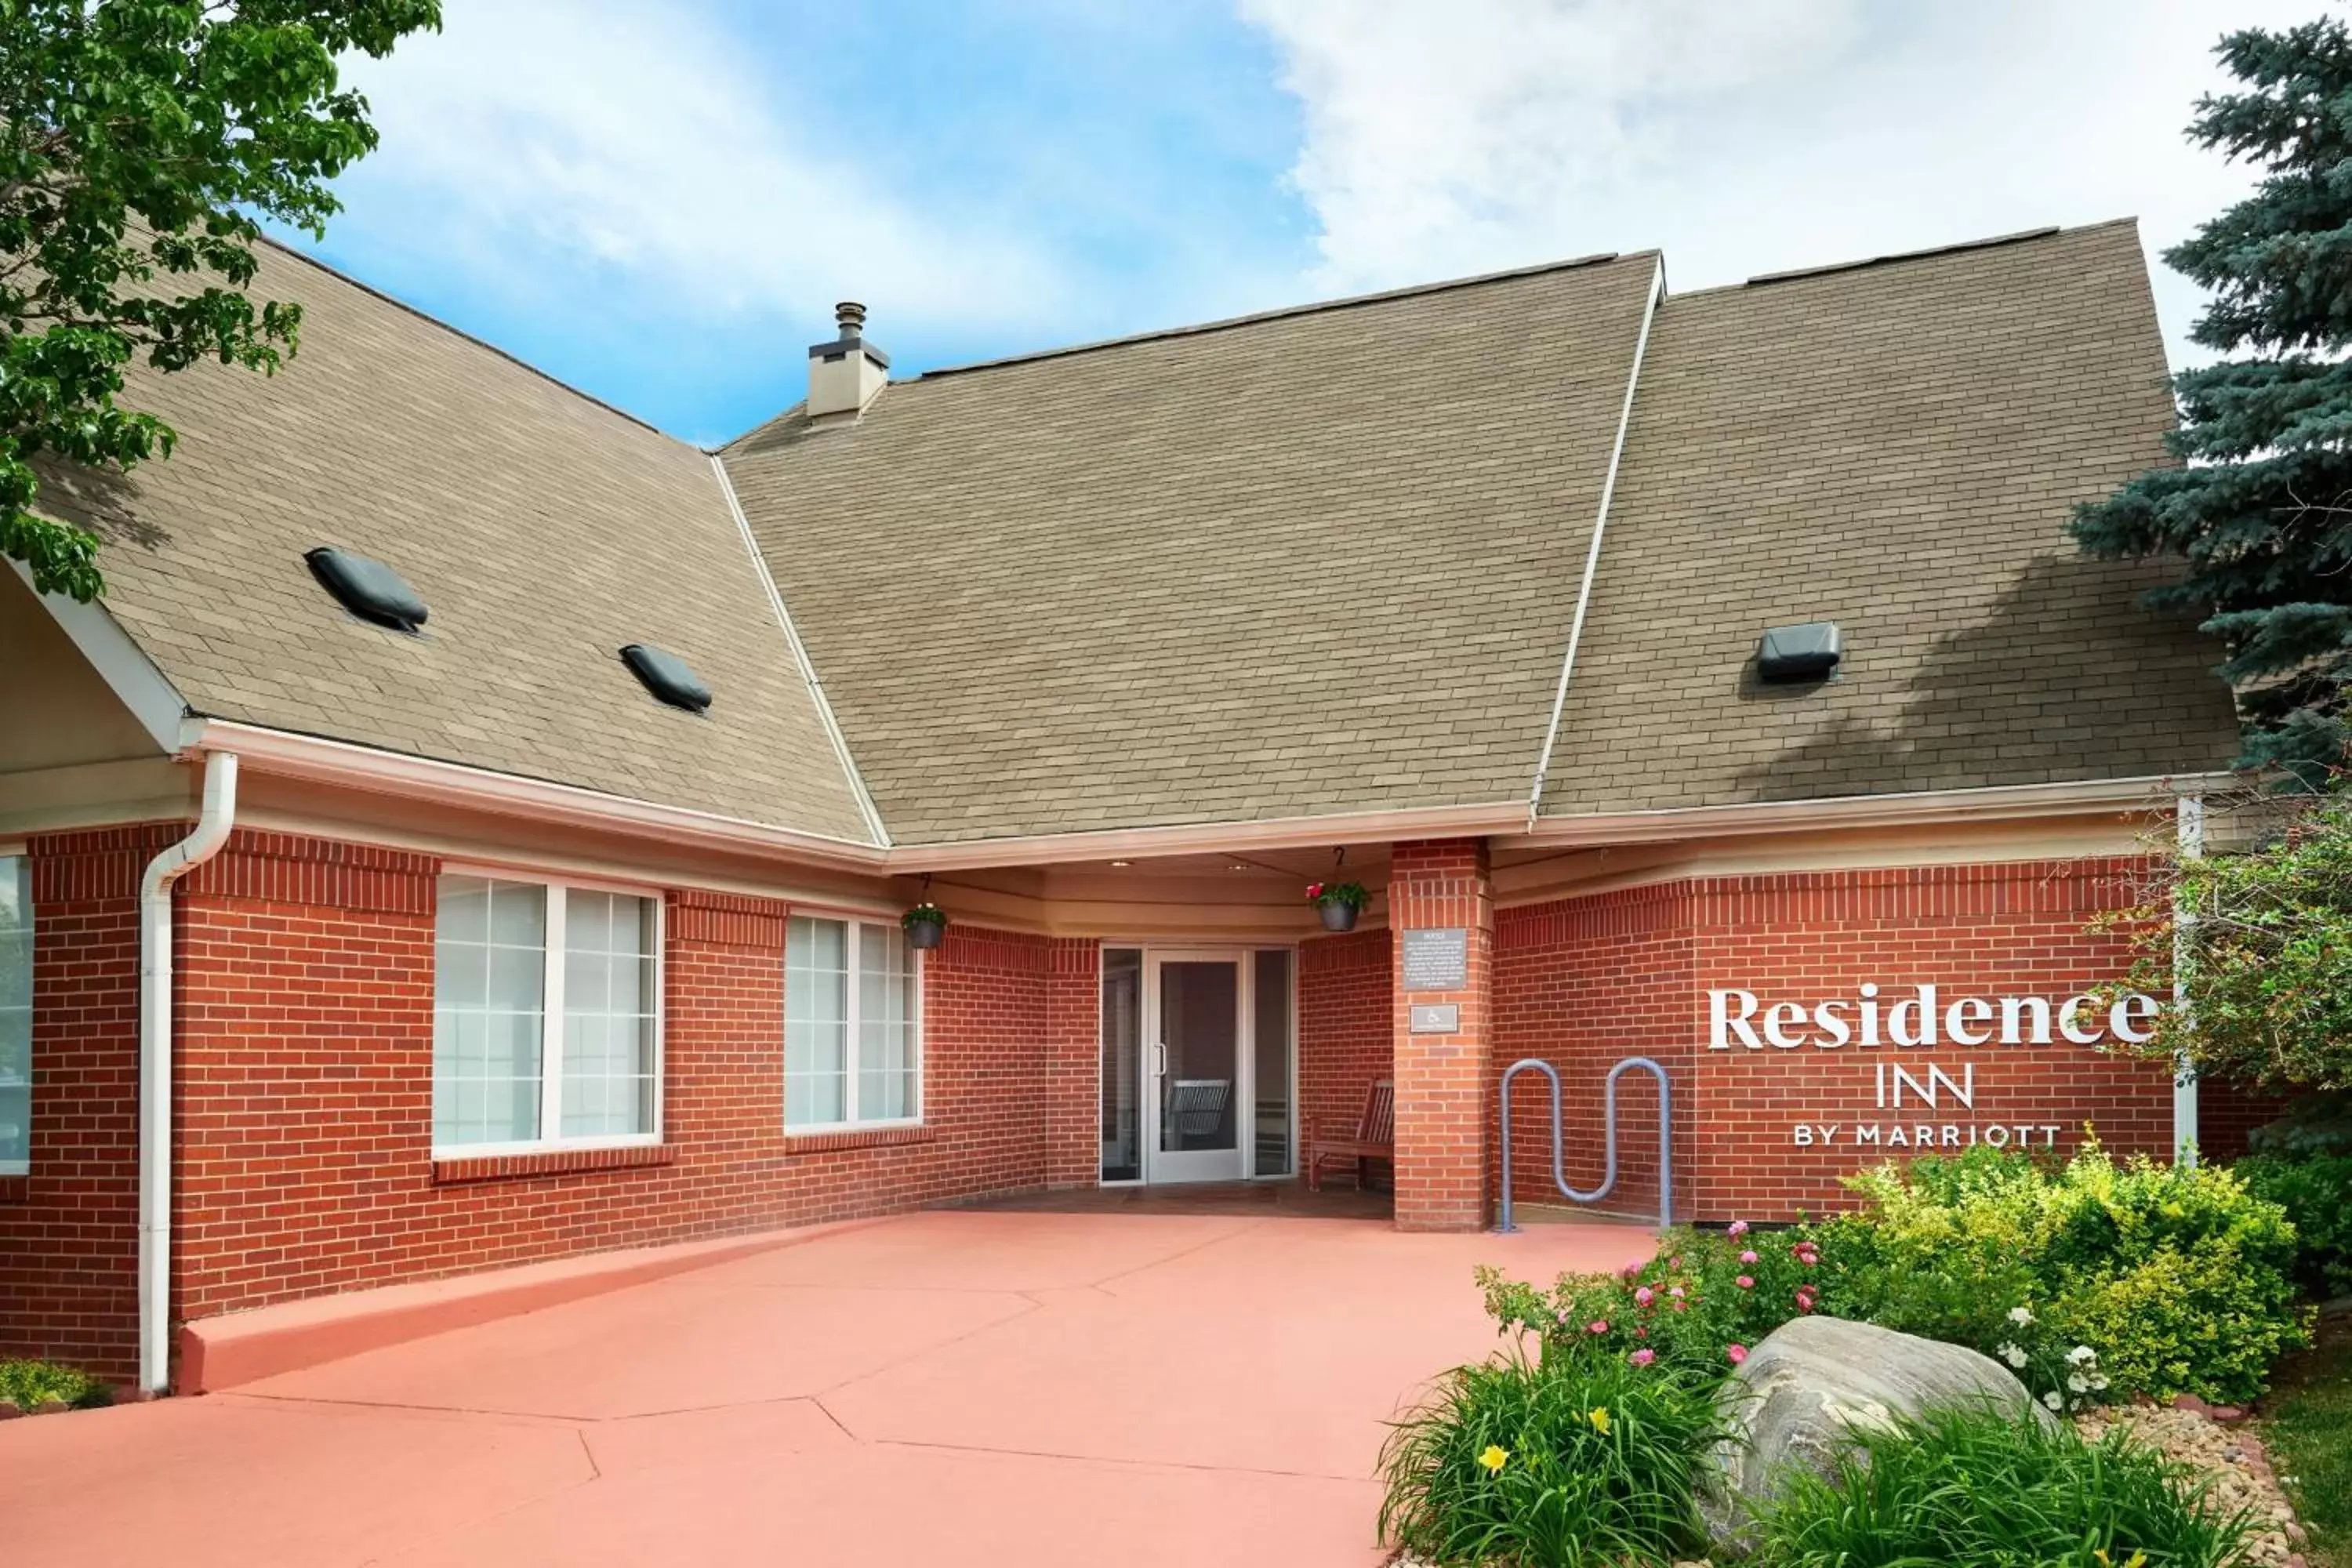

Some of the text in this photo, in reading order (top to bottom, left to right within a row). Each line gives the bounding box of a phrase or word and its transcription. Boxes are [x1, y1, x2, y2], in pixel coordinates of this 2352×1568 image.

[1707, 982, 2159, 1049] Residence
[1876, 1062, 1973, 1109] INN
[1794, 1124, 2061, 1148] BY MARRIOTT
